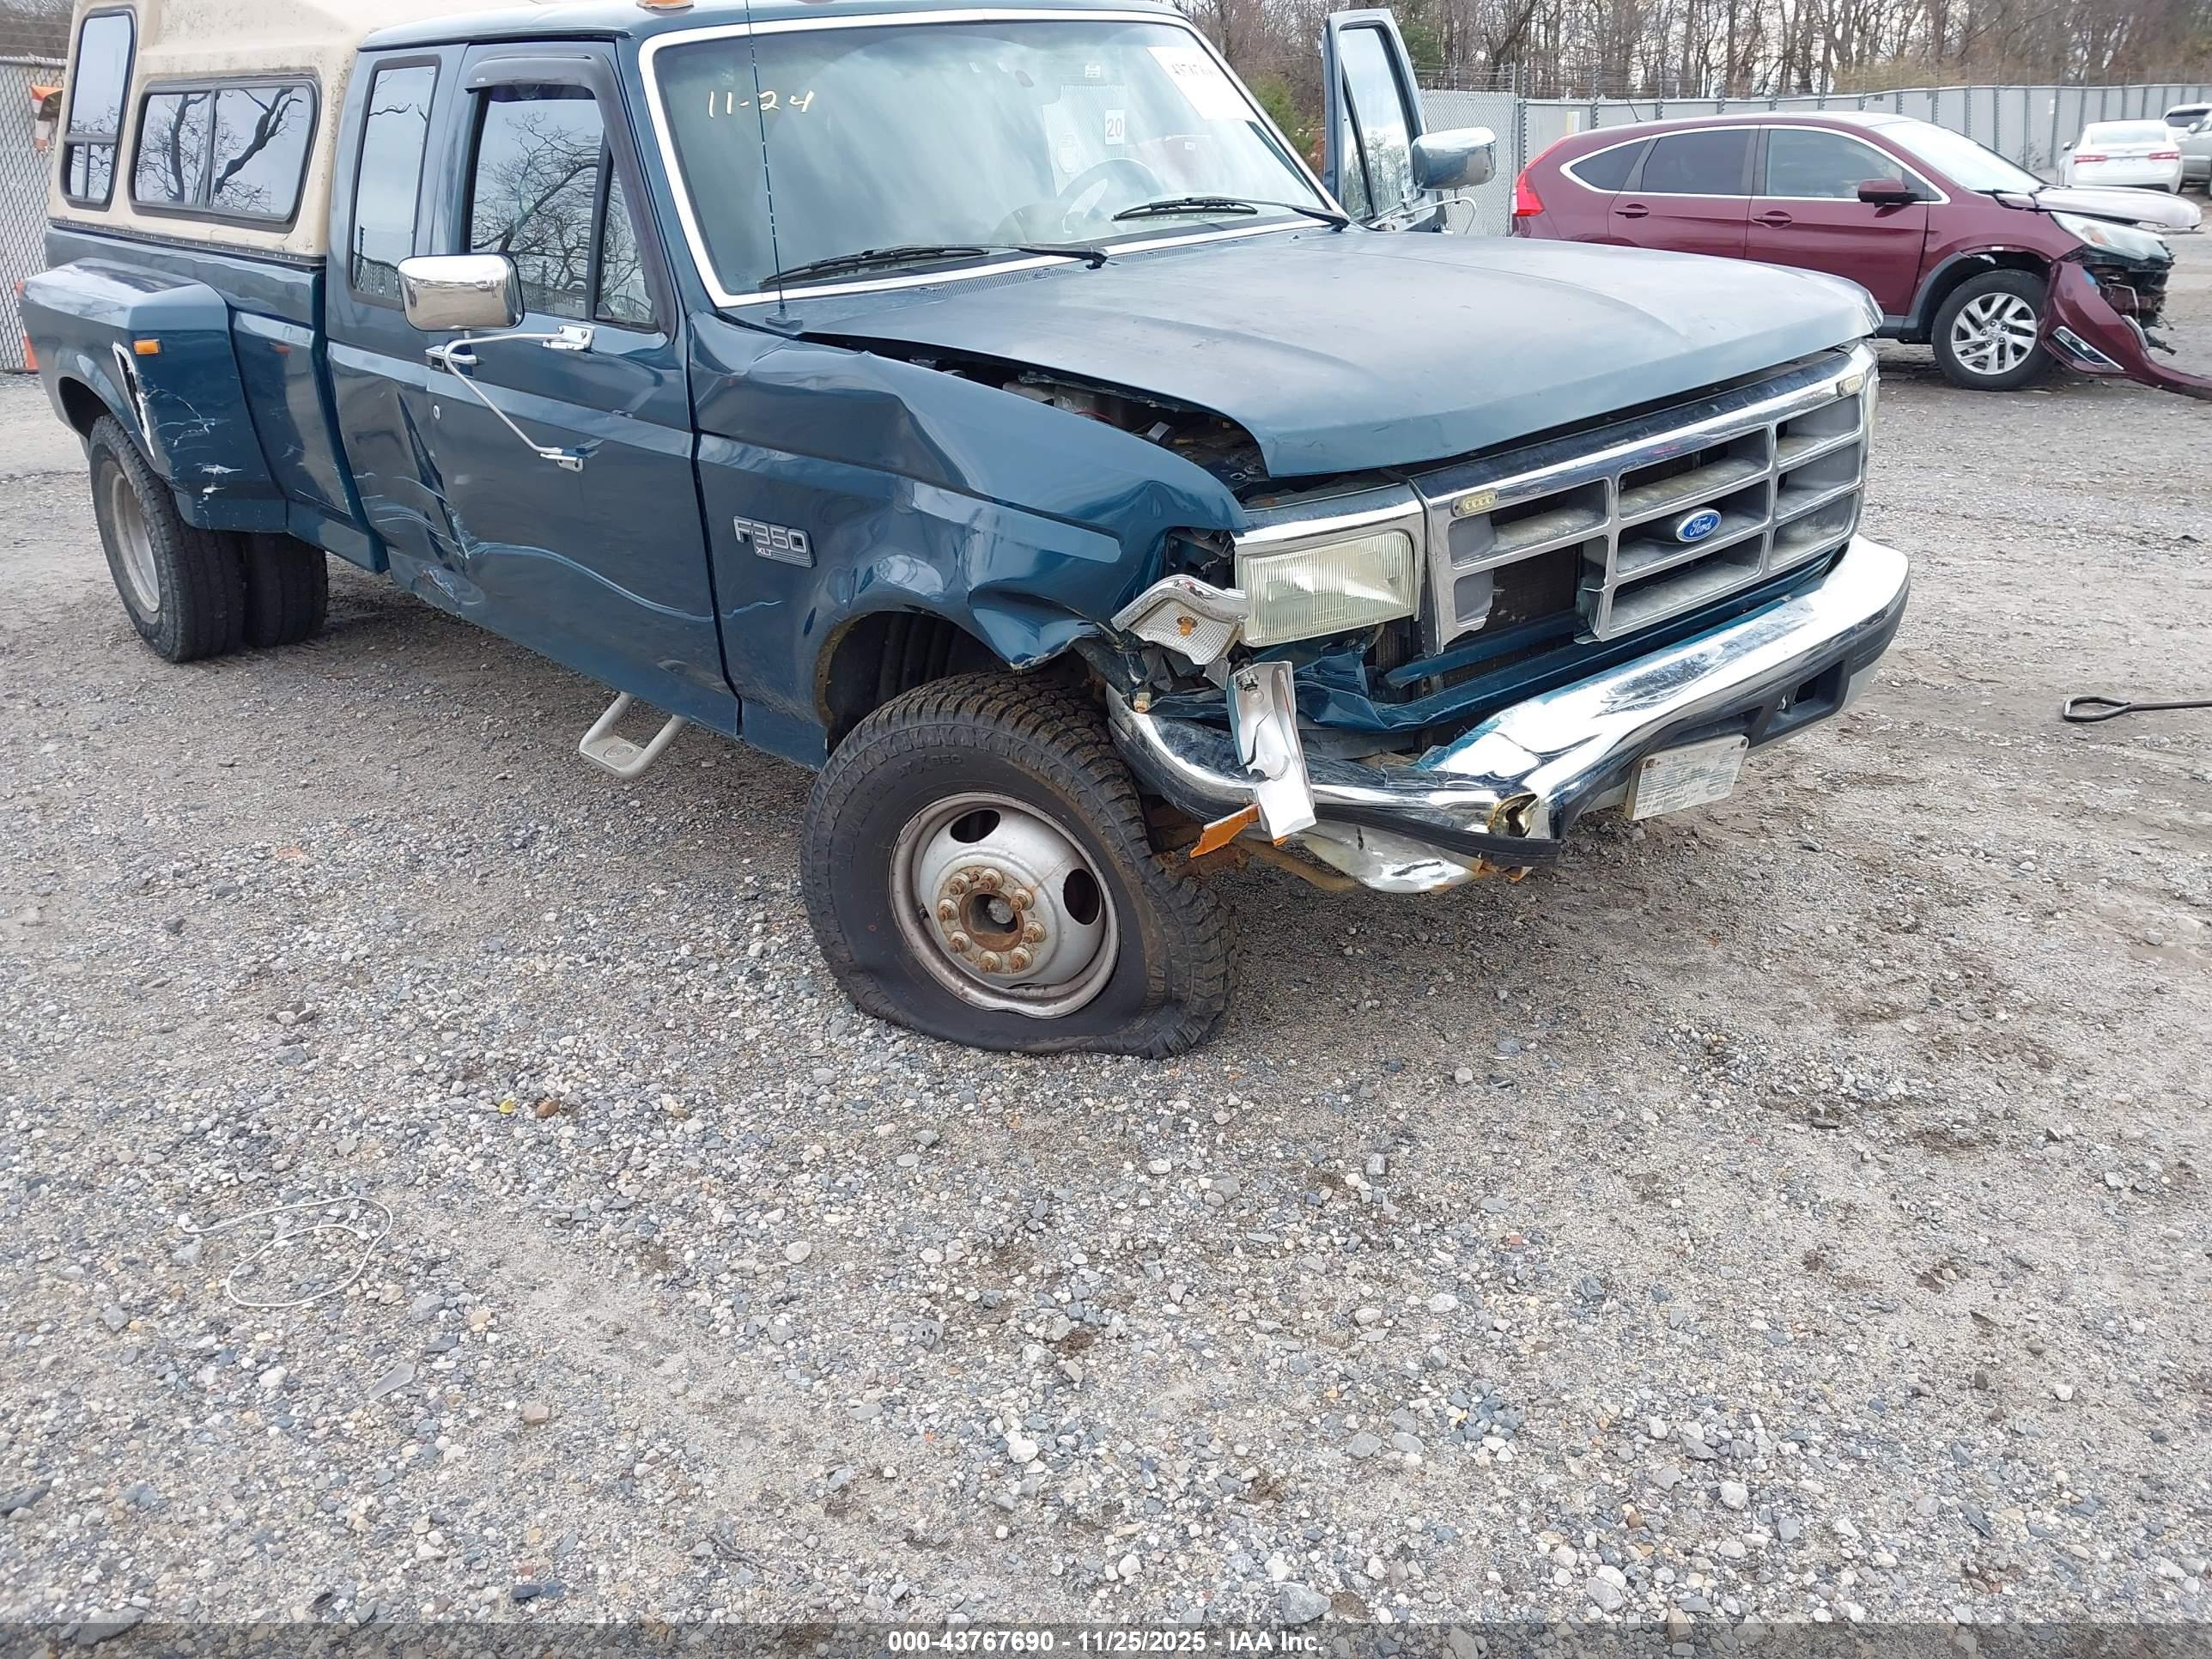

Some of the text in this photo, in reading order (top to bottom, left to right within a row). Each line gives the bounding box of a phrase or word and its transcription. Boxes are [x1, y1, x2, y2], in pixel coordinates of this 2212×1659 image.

[708, 90, 815, 118] 11-24
[1106, 118, 1123, 137] 20
[1689, 516, 1713, 536] Ford
[756, 546, 773, 556] XLT
